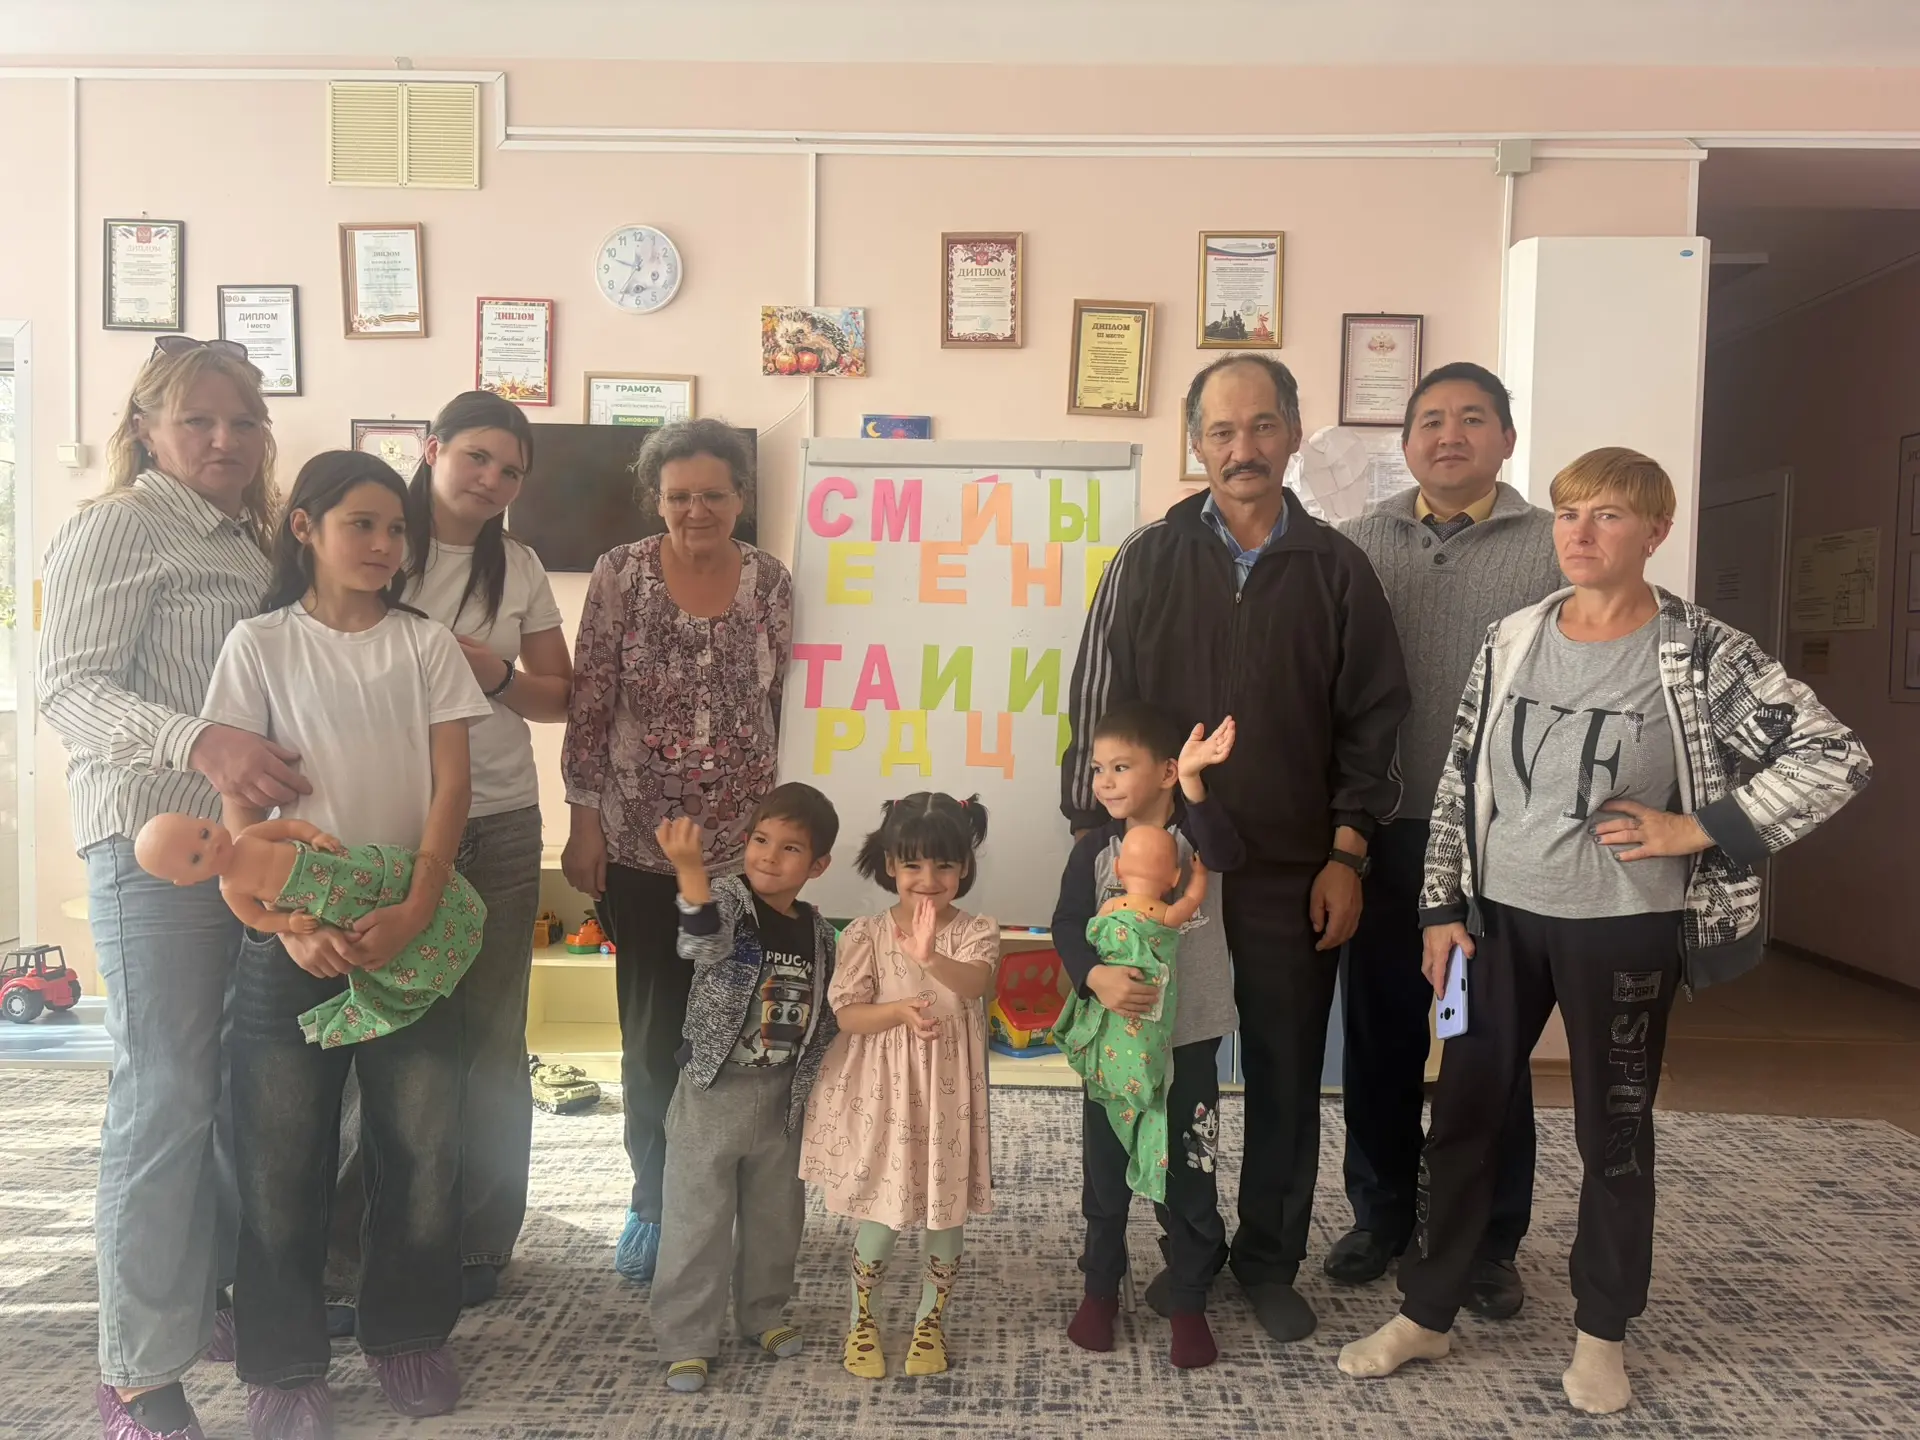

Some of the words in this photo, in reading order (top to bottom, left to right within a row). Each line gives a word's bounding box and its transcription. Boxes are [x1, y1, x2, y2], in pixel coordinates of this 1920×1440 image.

[617, 235, 627, 246] 11
[632, 231, 643, 242] 12
[606, 247, 617, 258] 10
[662, 247, 669, 258] 2
[603, 263, 610, 274] 9
[666, 263, 673, 274] 3
[957, 267, 1006, 278] ДИПЛОМ
[607, 279, 615, 290] 8
[635, 295, 641, 306] 6
[651, 291, 657, 302] 5
[238, 312, 278, 322] ДИПЛОМ
[494, 311, 535, 321] ДИПЛОМ
[1091, 323, 1130, 331] ДИПЛОМ
[615, 384, 662, 394] ГРАМОТА
[1617, 985, 1656, 998] SPORT
[1604, 1011, 1650, 1177] SPORT
